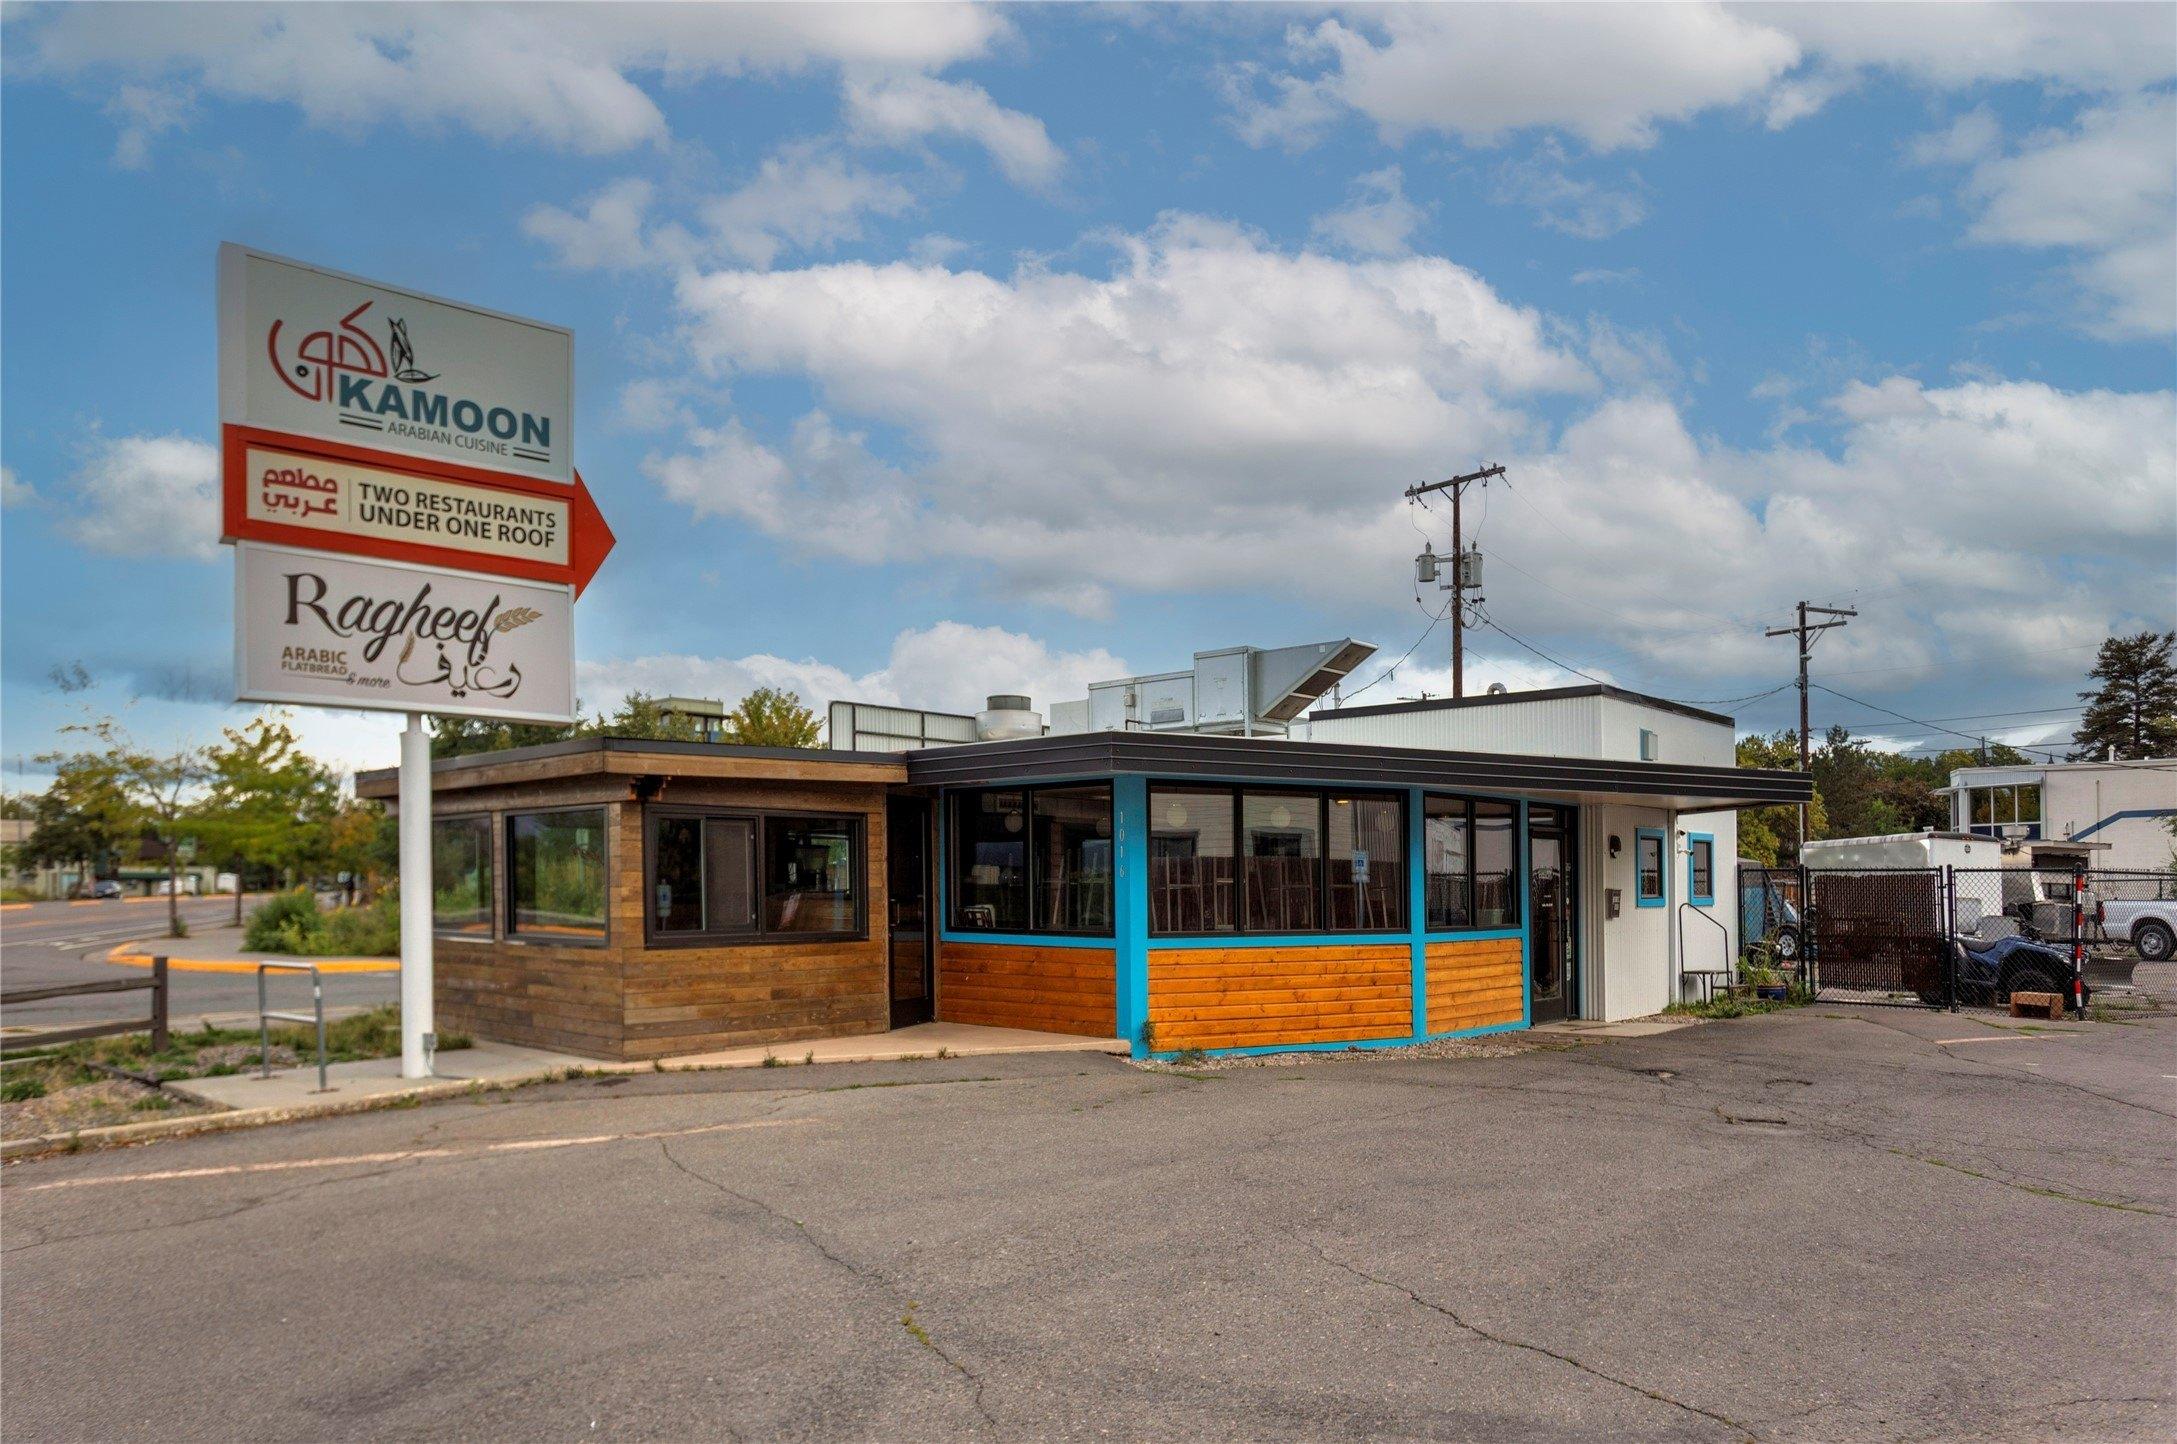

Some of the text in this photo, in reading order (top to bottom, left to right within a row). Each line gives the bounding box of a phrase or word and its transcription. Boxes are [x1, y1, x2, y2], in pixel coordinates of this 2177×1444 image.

[339, 374, 550, 447] KAMOON
[387, 422, 508, 456] ARABIAN CUISINE
[263, 468, 338, 493] مطعم
[263, 491, 338, 518] عربي
[358, 482, 556, 528] TWO RESTAURANTS
[359, 503, 555, 548] UNDER ONE ROOF
[282, 571, 501, 668] Ragheef
[281, 646, 348, 665] ARABIC
[281, 660, 348, 676] FLATBREAD
[357, 675, 391, 689] more
